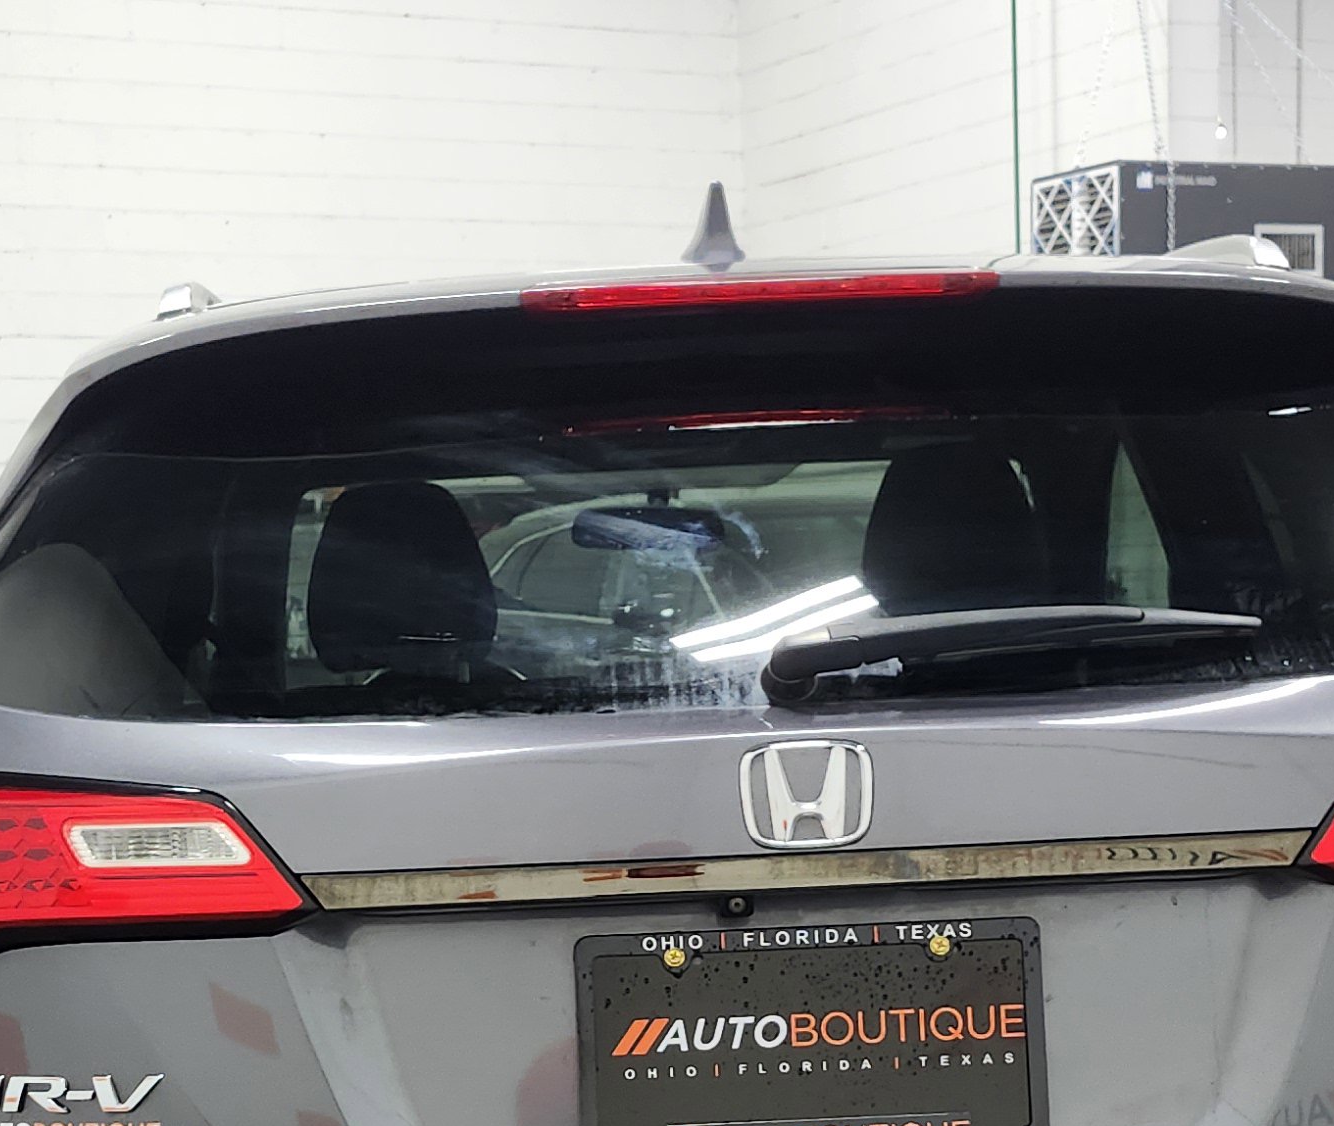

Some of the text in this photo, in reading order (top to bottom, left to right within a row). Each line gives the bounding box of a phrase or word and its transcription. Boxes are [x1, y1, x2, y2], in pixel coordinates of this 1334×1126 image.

[641, 921, 973, 953] OHIO FLORIDA TEXAS
[657, 1003, 1027, 1053] AUTOBOUTIQUE
[623, 1051, 1016, 1081] OHIO FLORIDA TEXAS
